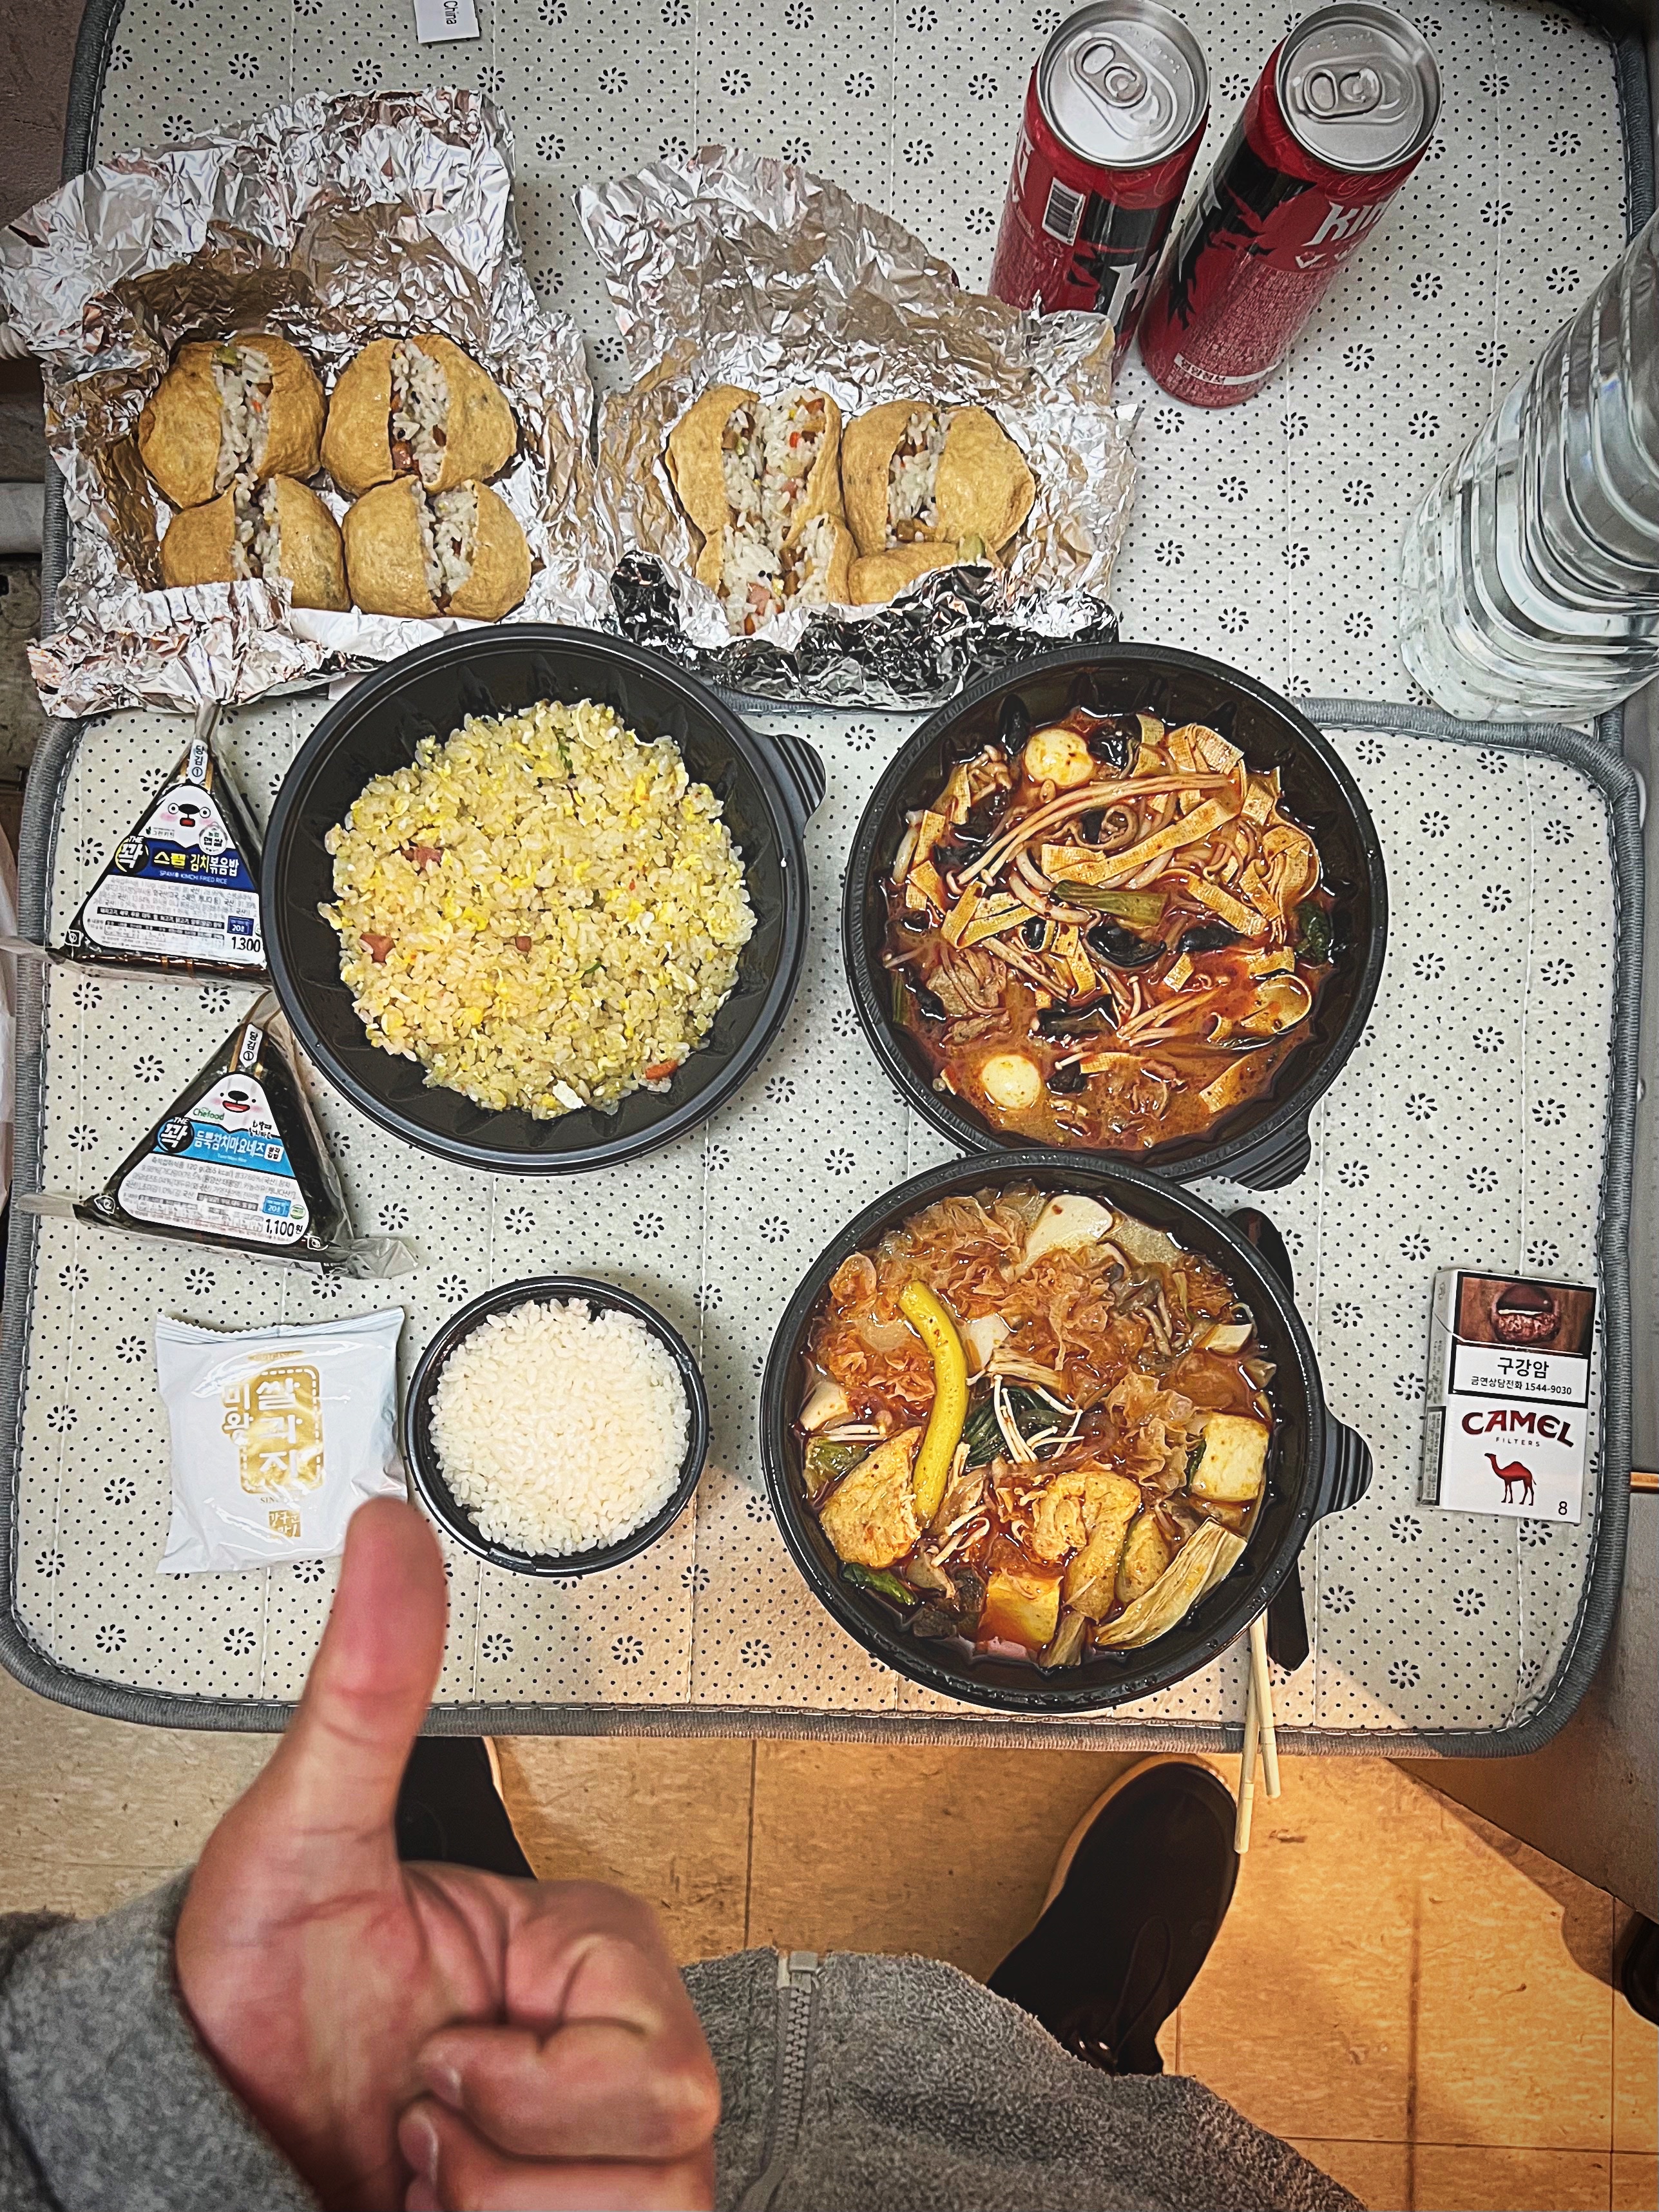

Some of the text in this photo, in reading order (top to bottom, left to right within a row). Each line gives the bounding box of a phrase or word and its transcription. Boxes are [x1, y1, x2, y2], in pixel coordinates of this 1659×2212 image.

[443, 1, 459, 24] China
[153, 851, 239, 877] 스팸 김치볶음밥
[193, 1108, 225, 1121] Chefood
[1497, 1357, 1549, 1379] 구강암
[1471, 1376, 1572, 1395] 금연상담전화 1544-9030
[1461, 1410, 1574, 1448] CAMEL
[1495, 1436, 1540, 1447] FILTERS
[1558, 1501, 1568, 1515] 8
